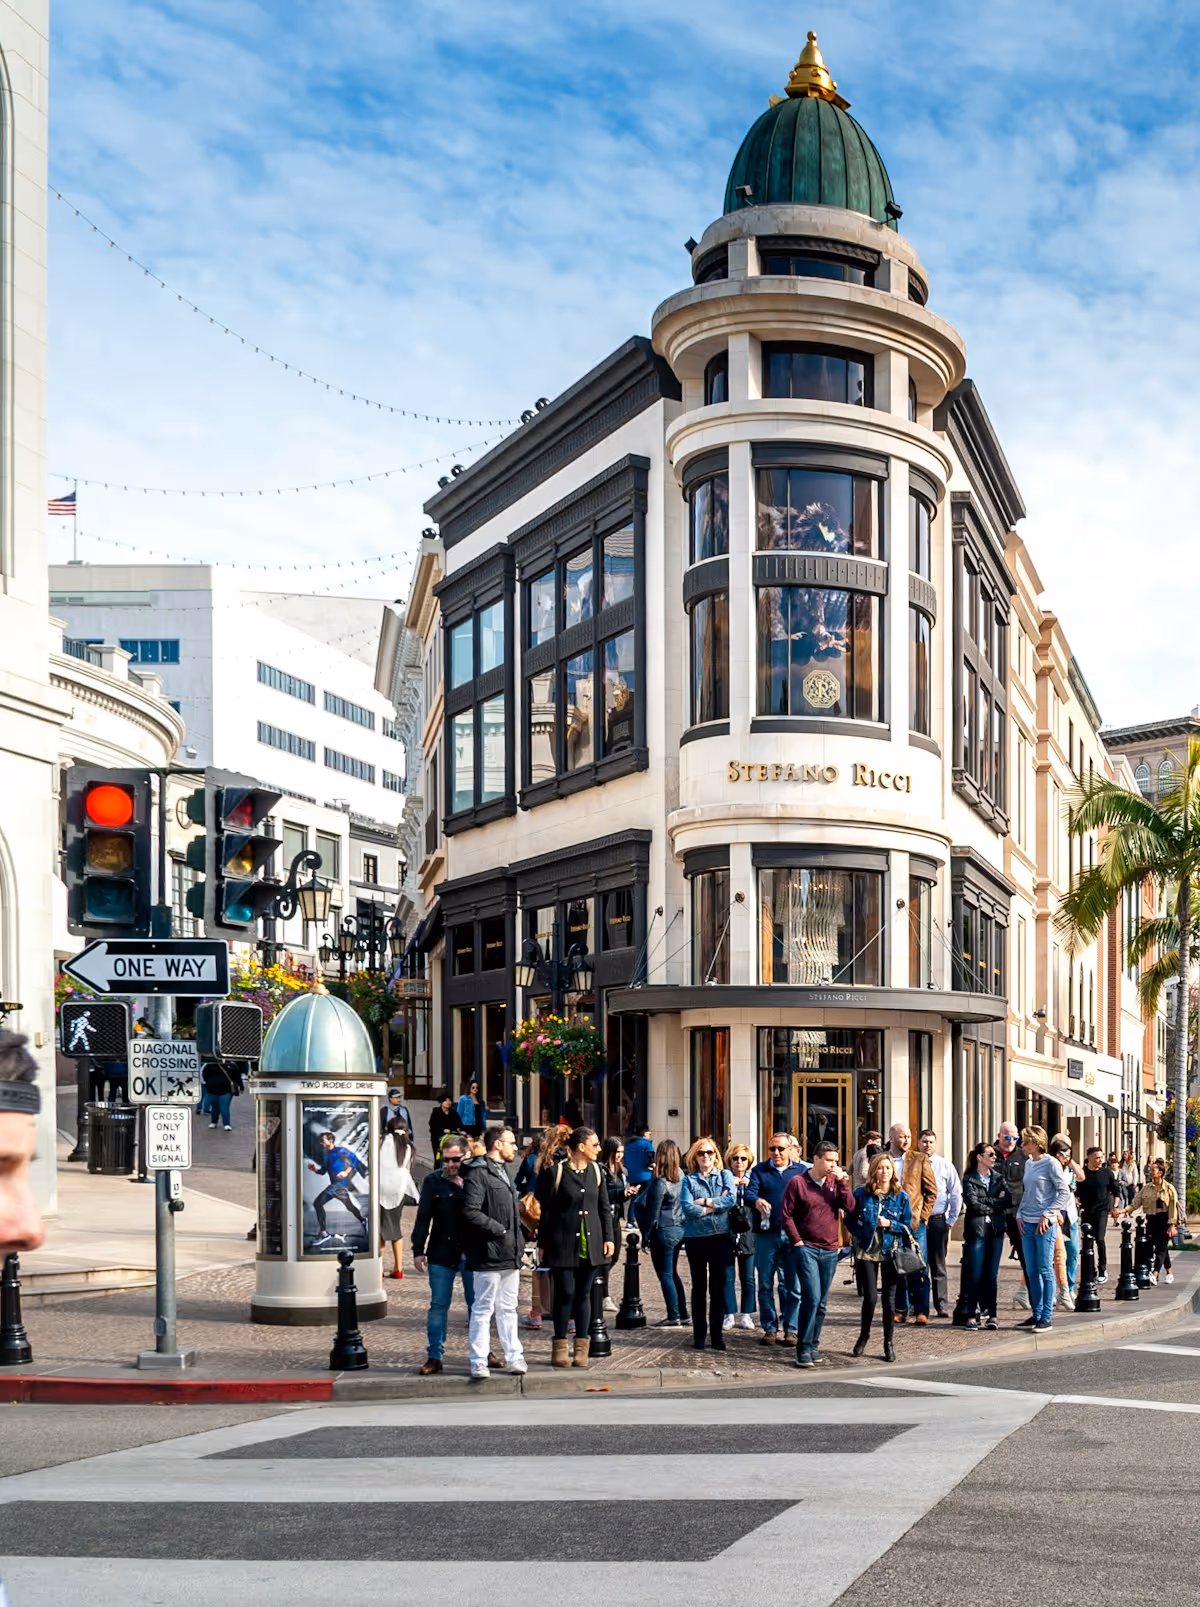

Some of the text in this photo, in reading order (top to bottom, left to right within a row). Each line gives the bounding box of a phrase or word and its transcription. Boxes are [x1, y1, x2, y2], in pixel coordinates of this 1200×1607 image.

[727, 759, 913, 793] STEFANO RICCI
[114, 958, 207, 977] ONE WAY
[808, 993, 867, 1001] STEFANO RICCI
[133, 1043, 196, 1055] DIAGONAL
[791, 1045, 853, 1054] STEFANO RICCI
[132, 1057, 197, 1069] CROSSING
[133, 1076, 157, 1095] OK
[322, 1081, 352, 1089] RODEO
[152, 1112, 185, 1120] CROSS
[156, 1123, 181, 1131] ONLY
[162, 1133, 176, 1141] ON
[156, 1144, 181, 1152] WALK
[152, 1154, 185, 1163] SIGNAL
